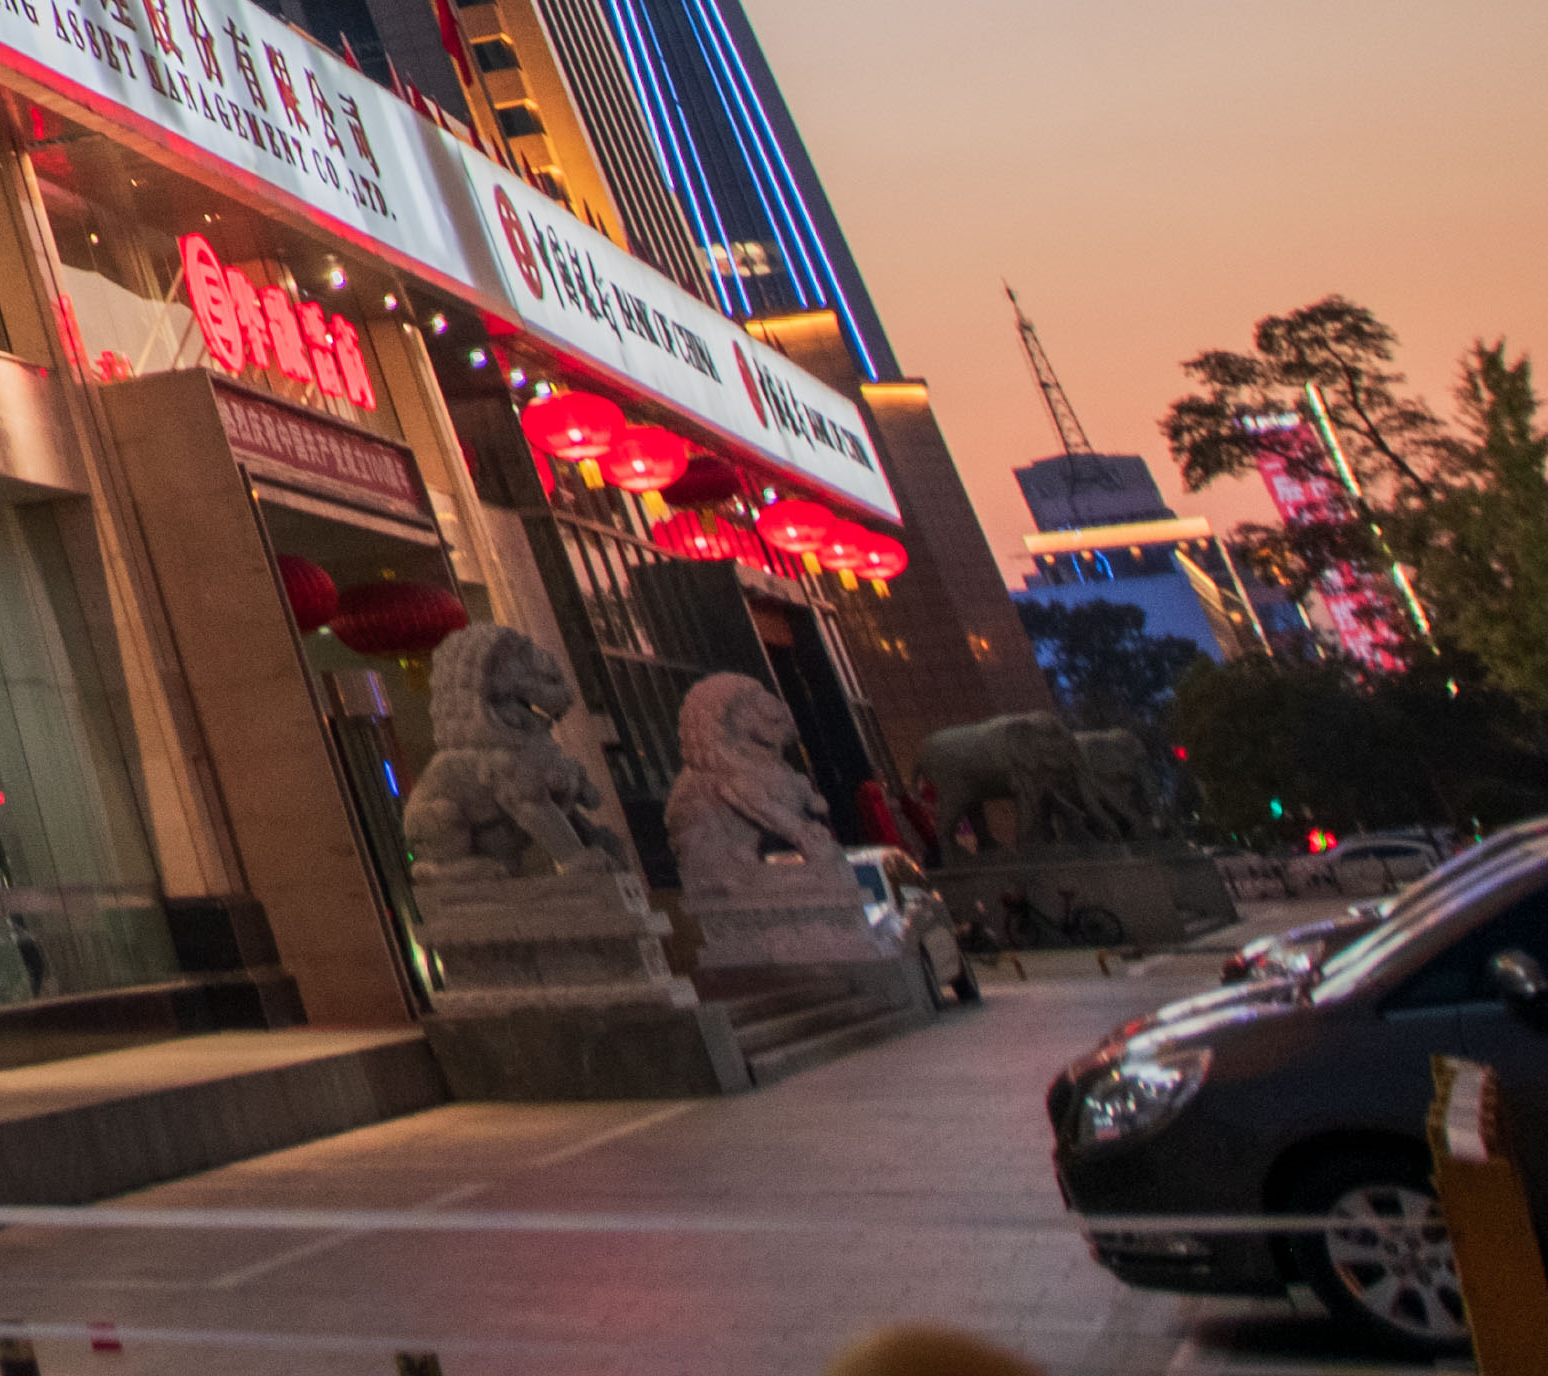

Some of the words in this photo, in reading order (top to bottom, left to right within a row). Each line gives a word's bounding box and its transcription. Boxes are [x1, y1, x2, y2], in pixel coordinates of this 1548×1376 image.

[139, 49, 309, 174] MANAGEMENT
[527, 211, 625, 344] 中国银行
[652, 308, 679, 358] OF
[672, 320, 724, 385] CHINA
